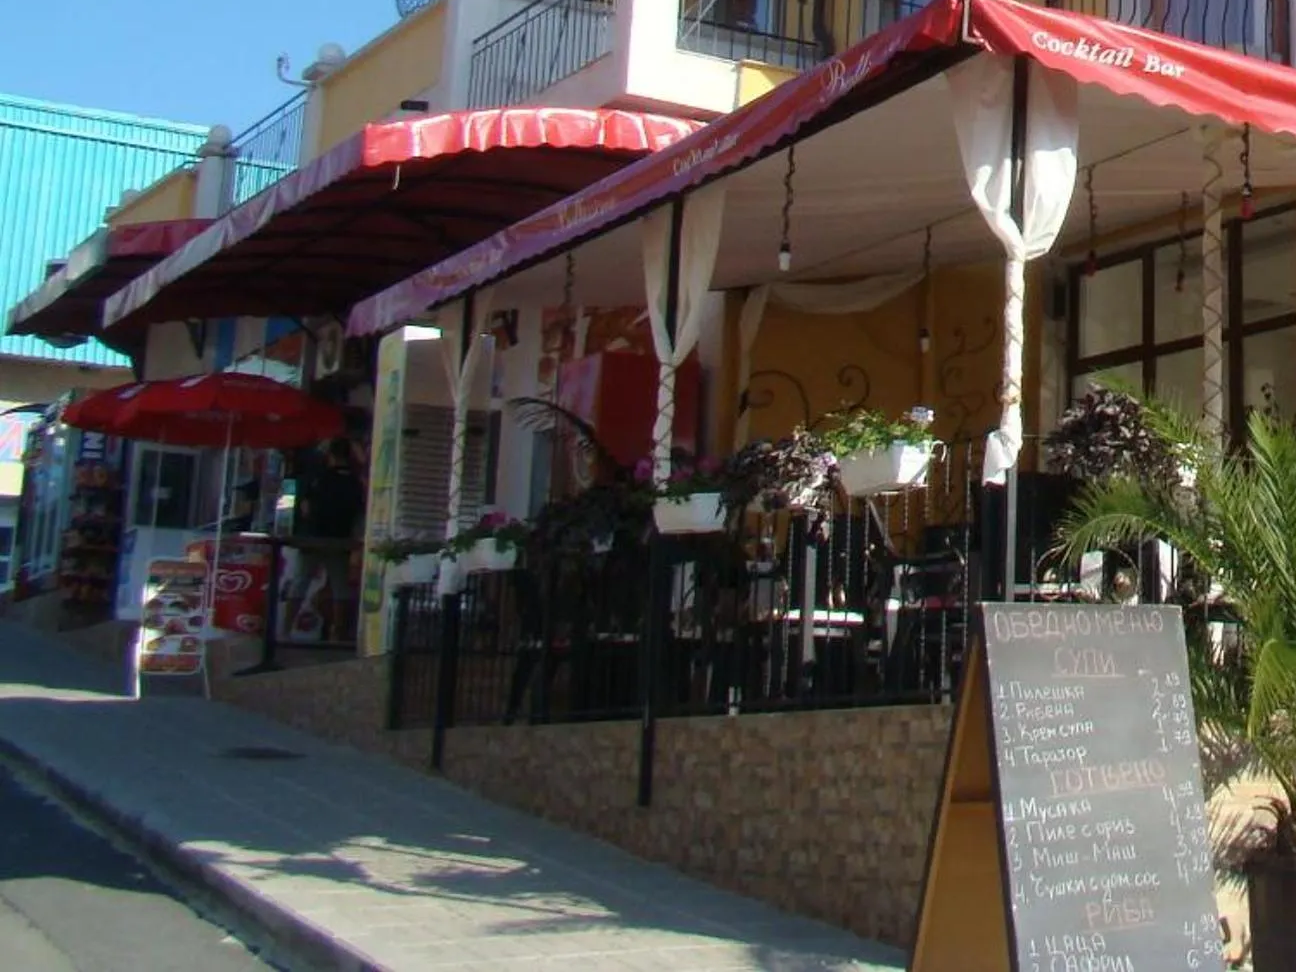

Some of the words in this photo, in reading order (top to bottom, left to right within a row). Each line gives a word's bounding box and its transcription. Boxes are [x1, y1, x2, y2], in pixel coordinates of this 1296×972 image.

[1031, 31, 1134, 69] Cocktail
[1143, 54, 1185, 78] Bar
[1054, 647, 1116, 675] СУПИ
[1026, 820, 1076, 843] Пиле
